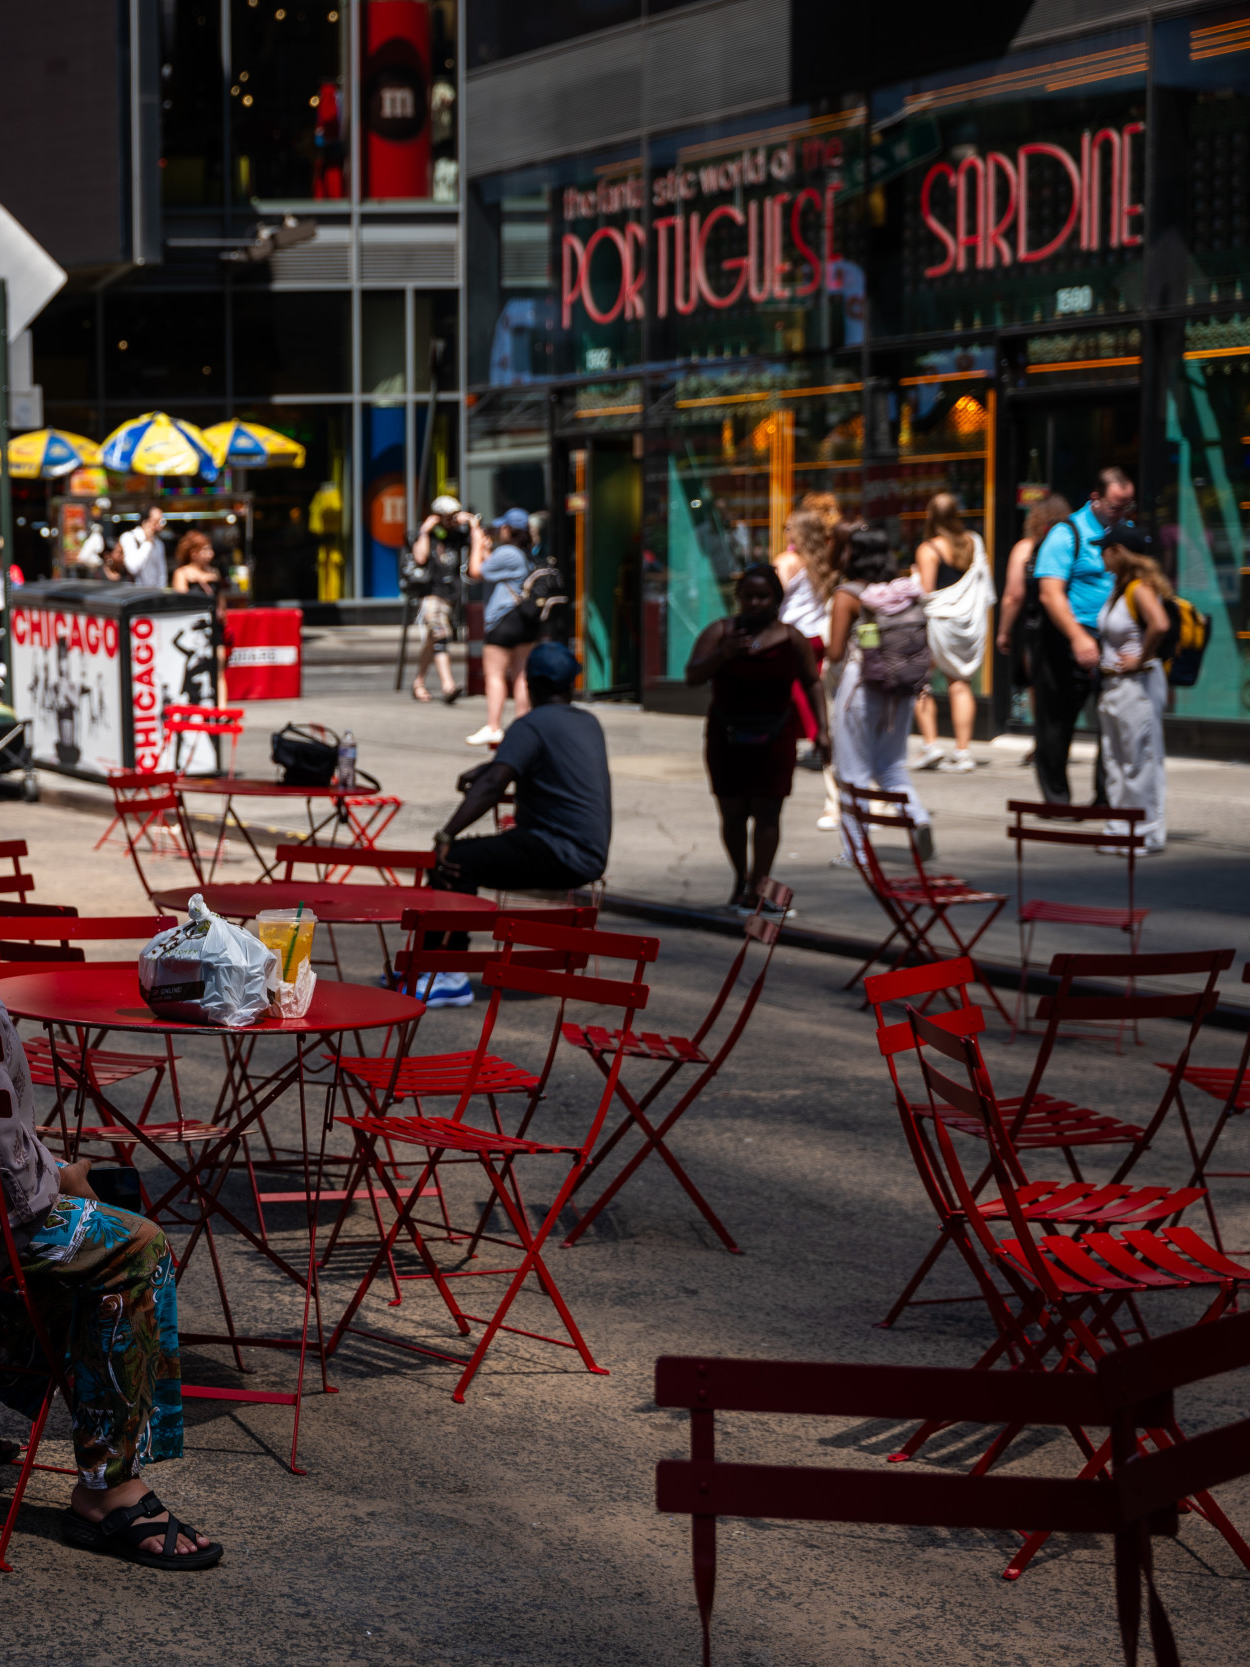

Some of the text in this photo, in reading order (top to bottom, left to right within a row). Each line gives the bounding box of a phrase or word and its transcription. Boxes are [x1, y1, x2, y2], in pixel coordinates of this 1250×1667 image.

[380, 87, 415, 119] m
[700, 146, 766, 194] world
[770, 140, 796, 178] of
[920, 121, 1146, 279] SARDINE
[561, 181, 845, 330] PORTUGUESE
[11, 606, 120, 659] CHICAGO
[129, 616, 161, 775] CHICAGO
